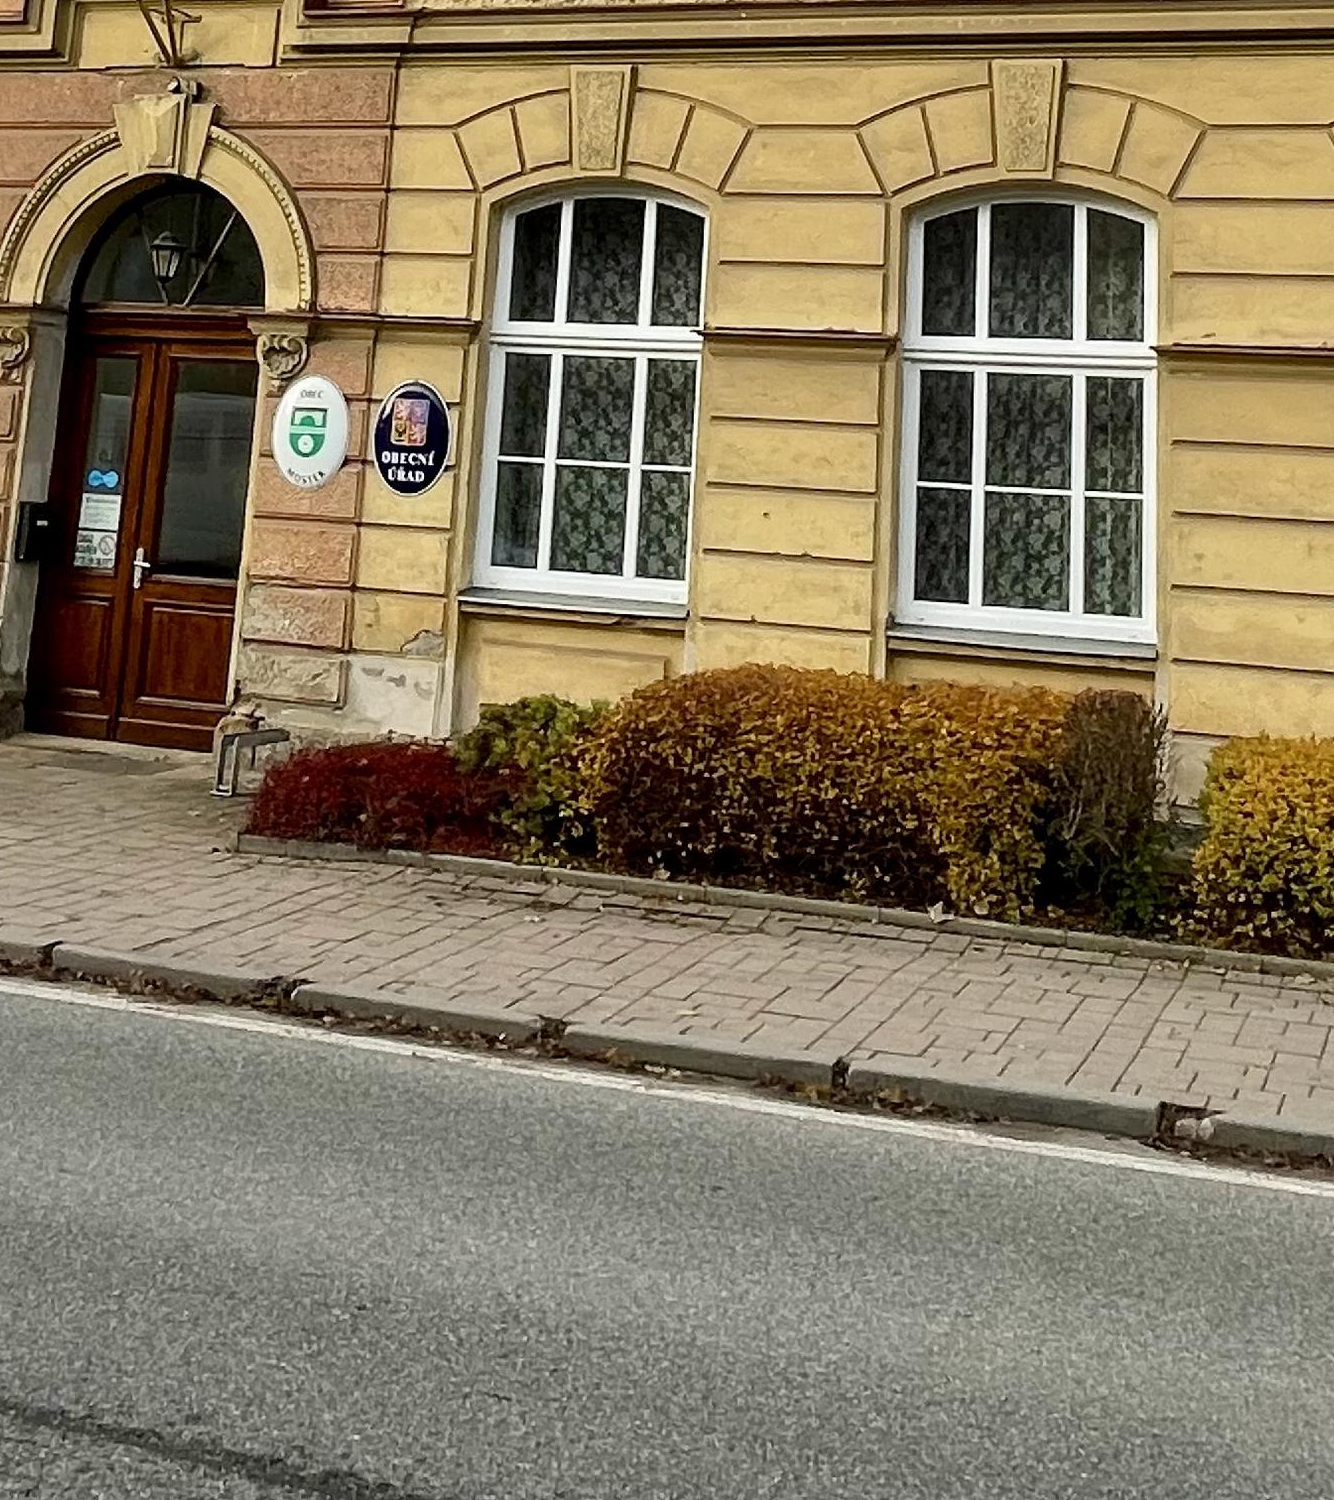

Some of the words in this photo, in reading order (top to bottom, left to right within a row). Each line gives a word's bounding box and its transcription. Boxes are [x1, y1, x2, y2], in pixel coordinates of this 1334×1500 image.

[300, 389, 324, 399] OBEC
[381, 450, 436, 466] OBECNÍ
[387, 466, 425, 483] ÚŘAD
